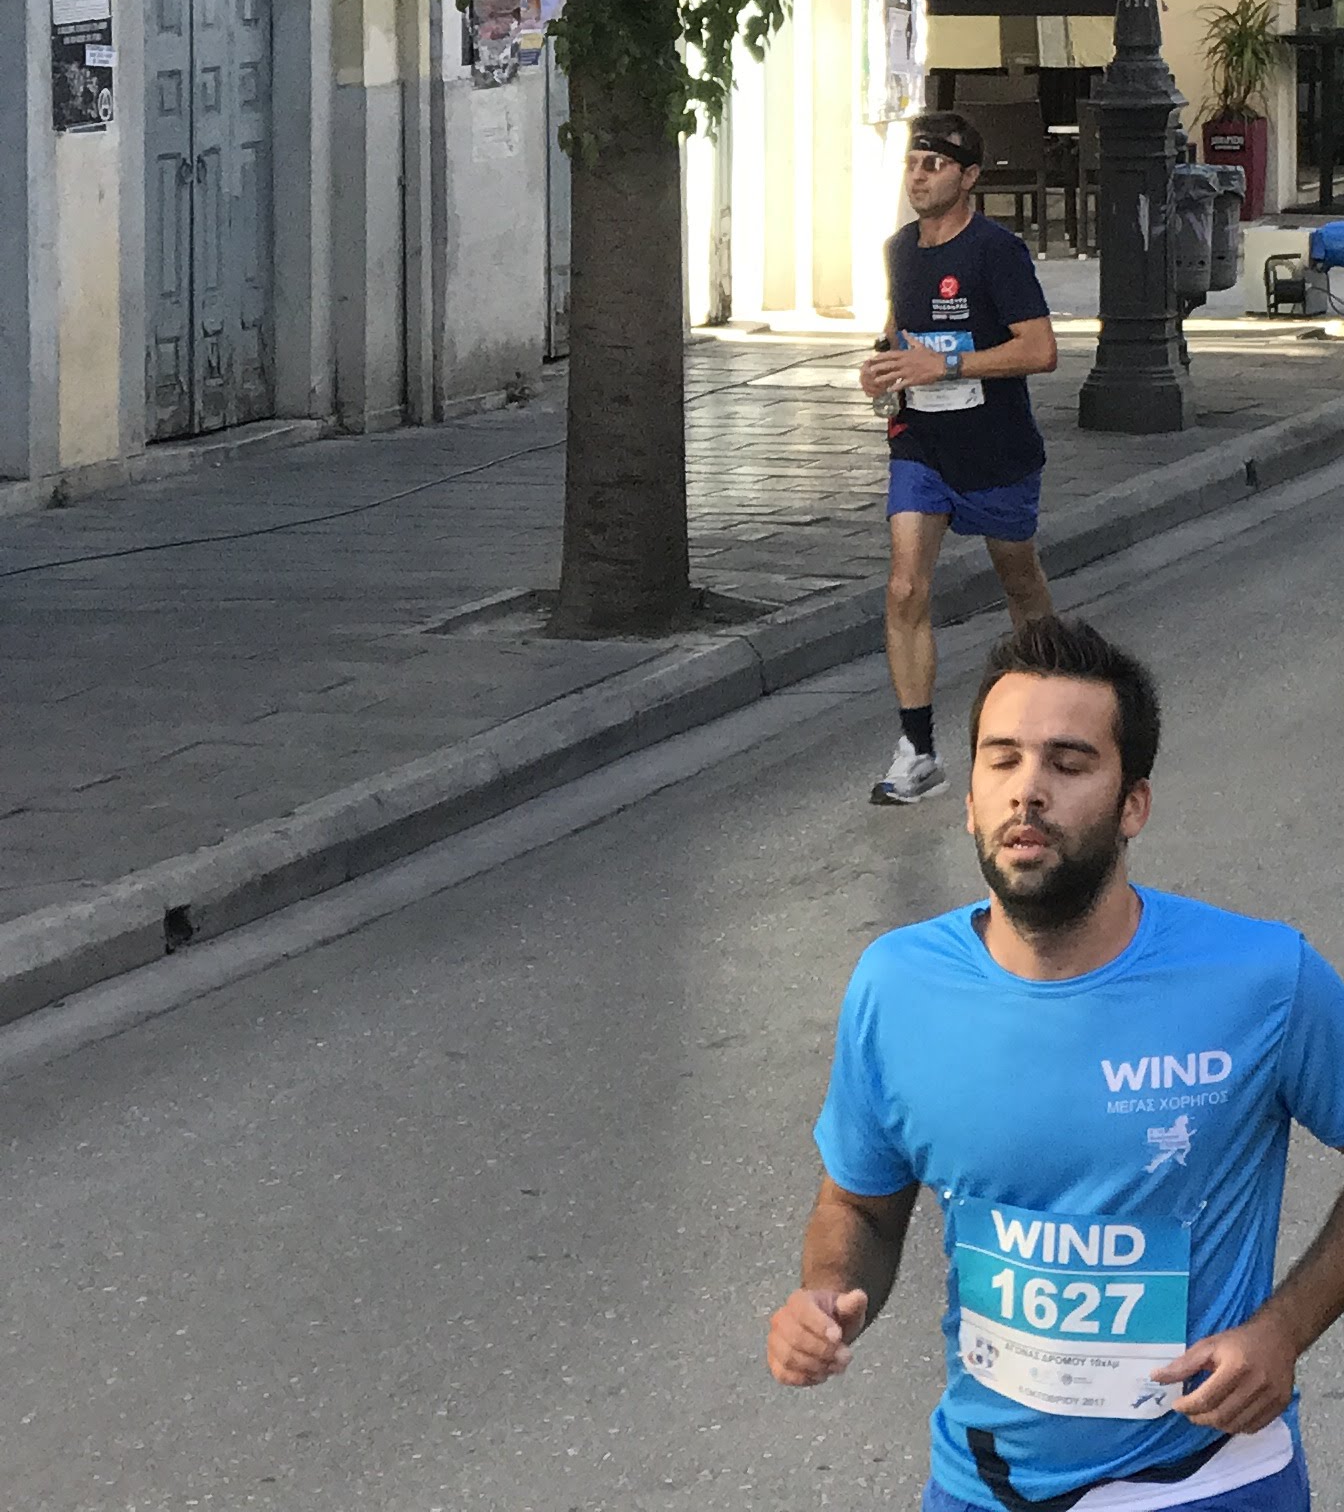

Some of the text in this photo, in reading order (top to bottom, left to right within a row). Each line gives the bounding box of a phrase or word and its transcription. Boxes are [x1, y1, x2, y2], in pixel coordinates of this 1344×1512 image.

[1101, 1050, 1233, 1092] WIND
[1106, 1090, 1230, 1114] ΜΕΓΑΣ ΧΟΡΗΓΟΣ
[991, 1208, 1146, 1266] WIND
[991, 1268, 1146, 1335] 1627
